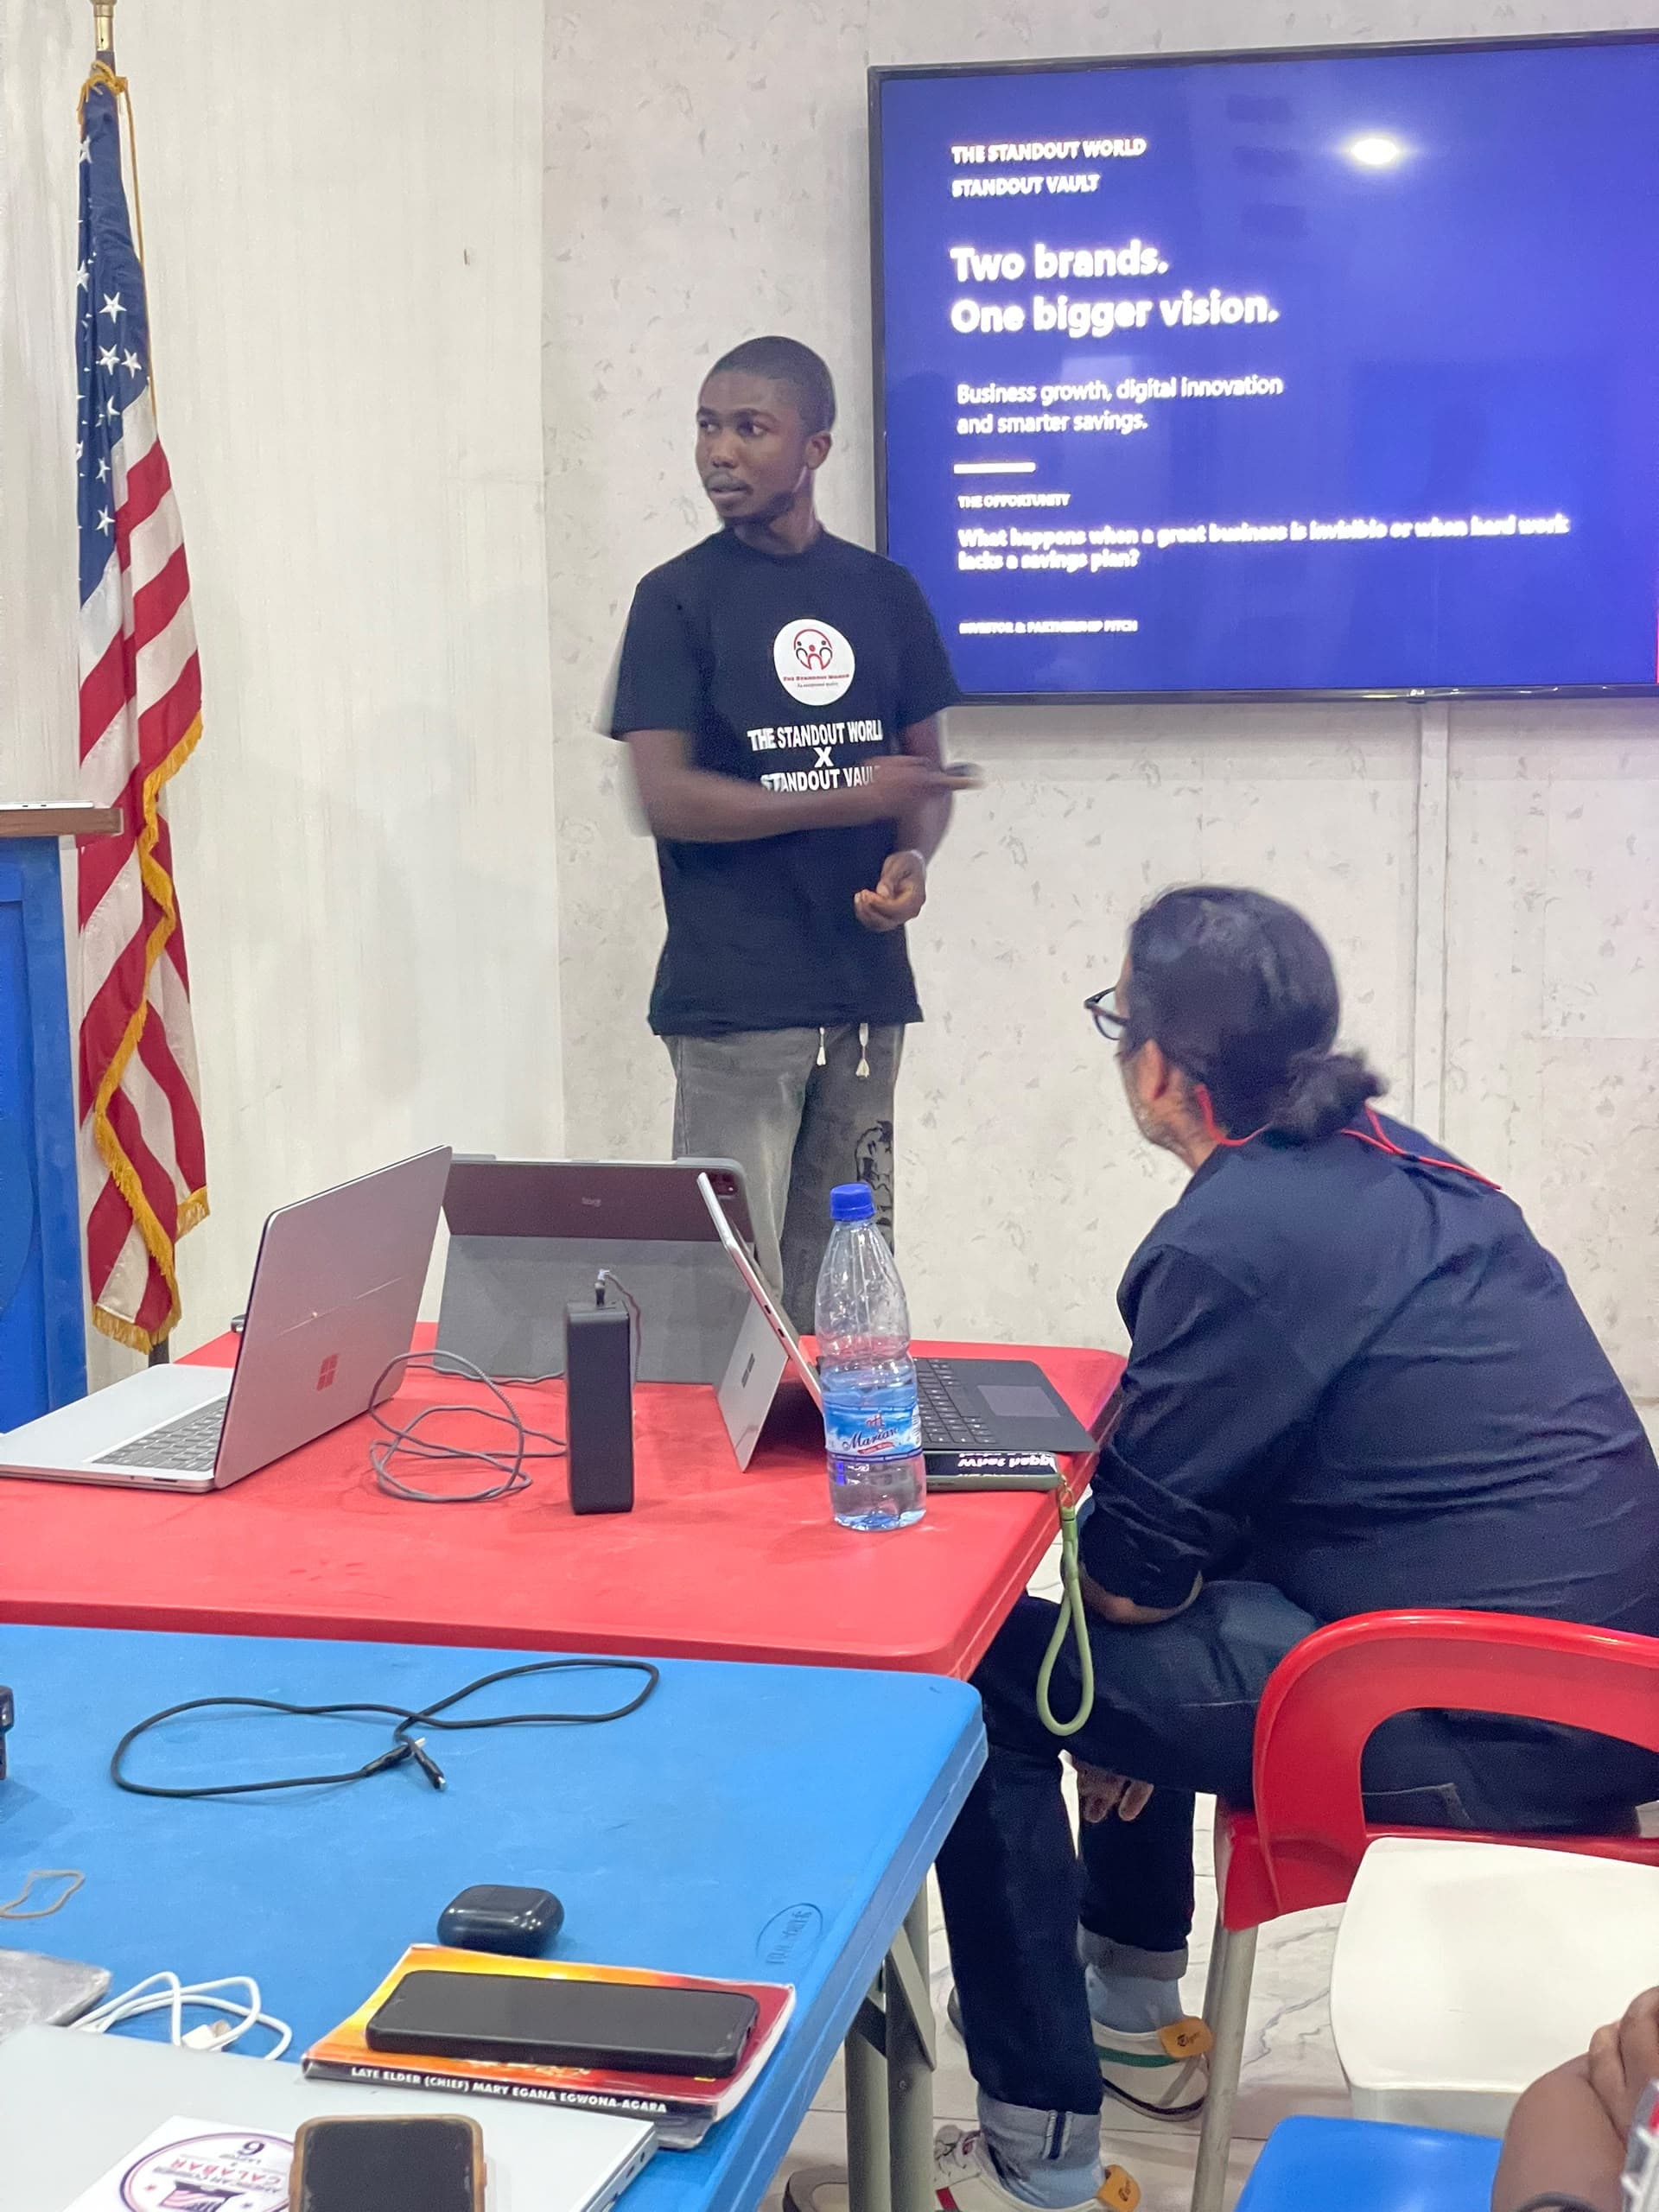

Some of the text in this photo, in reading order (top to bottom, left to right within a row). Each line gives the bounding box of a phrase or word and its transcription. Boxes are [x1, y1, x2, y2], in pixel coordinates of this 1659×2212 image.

[951, 138, 1147, 164] THE STANDOUT WORLD
[952, 175, 1100, 197] STANDOUT VAULT
[950, 238, 1168, 282] Two brands.
[951, 289, 1279, 338] One bigger vision.
[957, 374, 1283, 406] Business growth, digital innovation
[957, 410, 1147, 435] and smarter savings.
[958, 493, 1071, 508] THE OPPORTUNITY
[957, 529, 1007, 547] What
[1010, 528, 1086, 550] happens
[1089, 525, 1139, 544] when
[1141, 529, 1154, 544] a
[1157, 524, 1207, 549] great
[1209, 523, 1287, 542] business
[1290, 520, 1307, 541] is
[1389, 522, 1414, 538] or
[1414, 517, 1468, 537] when
[1470, 515, 1516, 537] hard
[1518, 512, 1571, 534] work
[958, 548, 1140, 574] lacks a savings plan?
[747, 728, 777, 751] THE
[777, 724, 845, 748] STANDOUT
[813, 746, 834, 768] X
[352, 2066, 380, 2080] LATE
[383, 2070, 421, 2085] ELDER
[424, 2075, 469, 2093] (CHIEF)
[472, 2082, 510, 2095] MARY
[512, 2087, 556, 2101] EGANA
[171, 2158, 282, 2185] CALABAR
